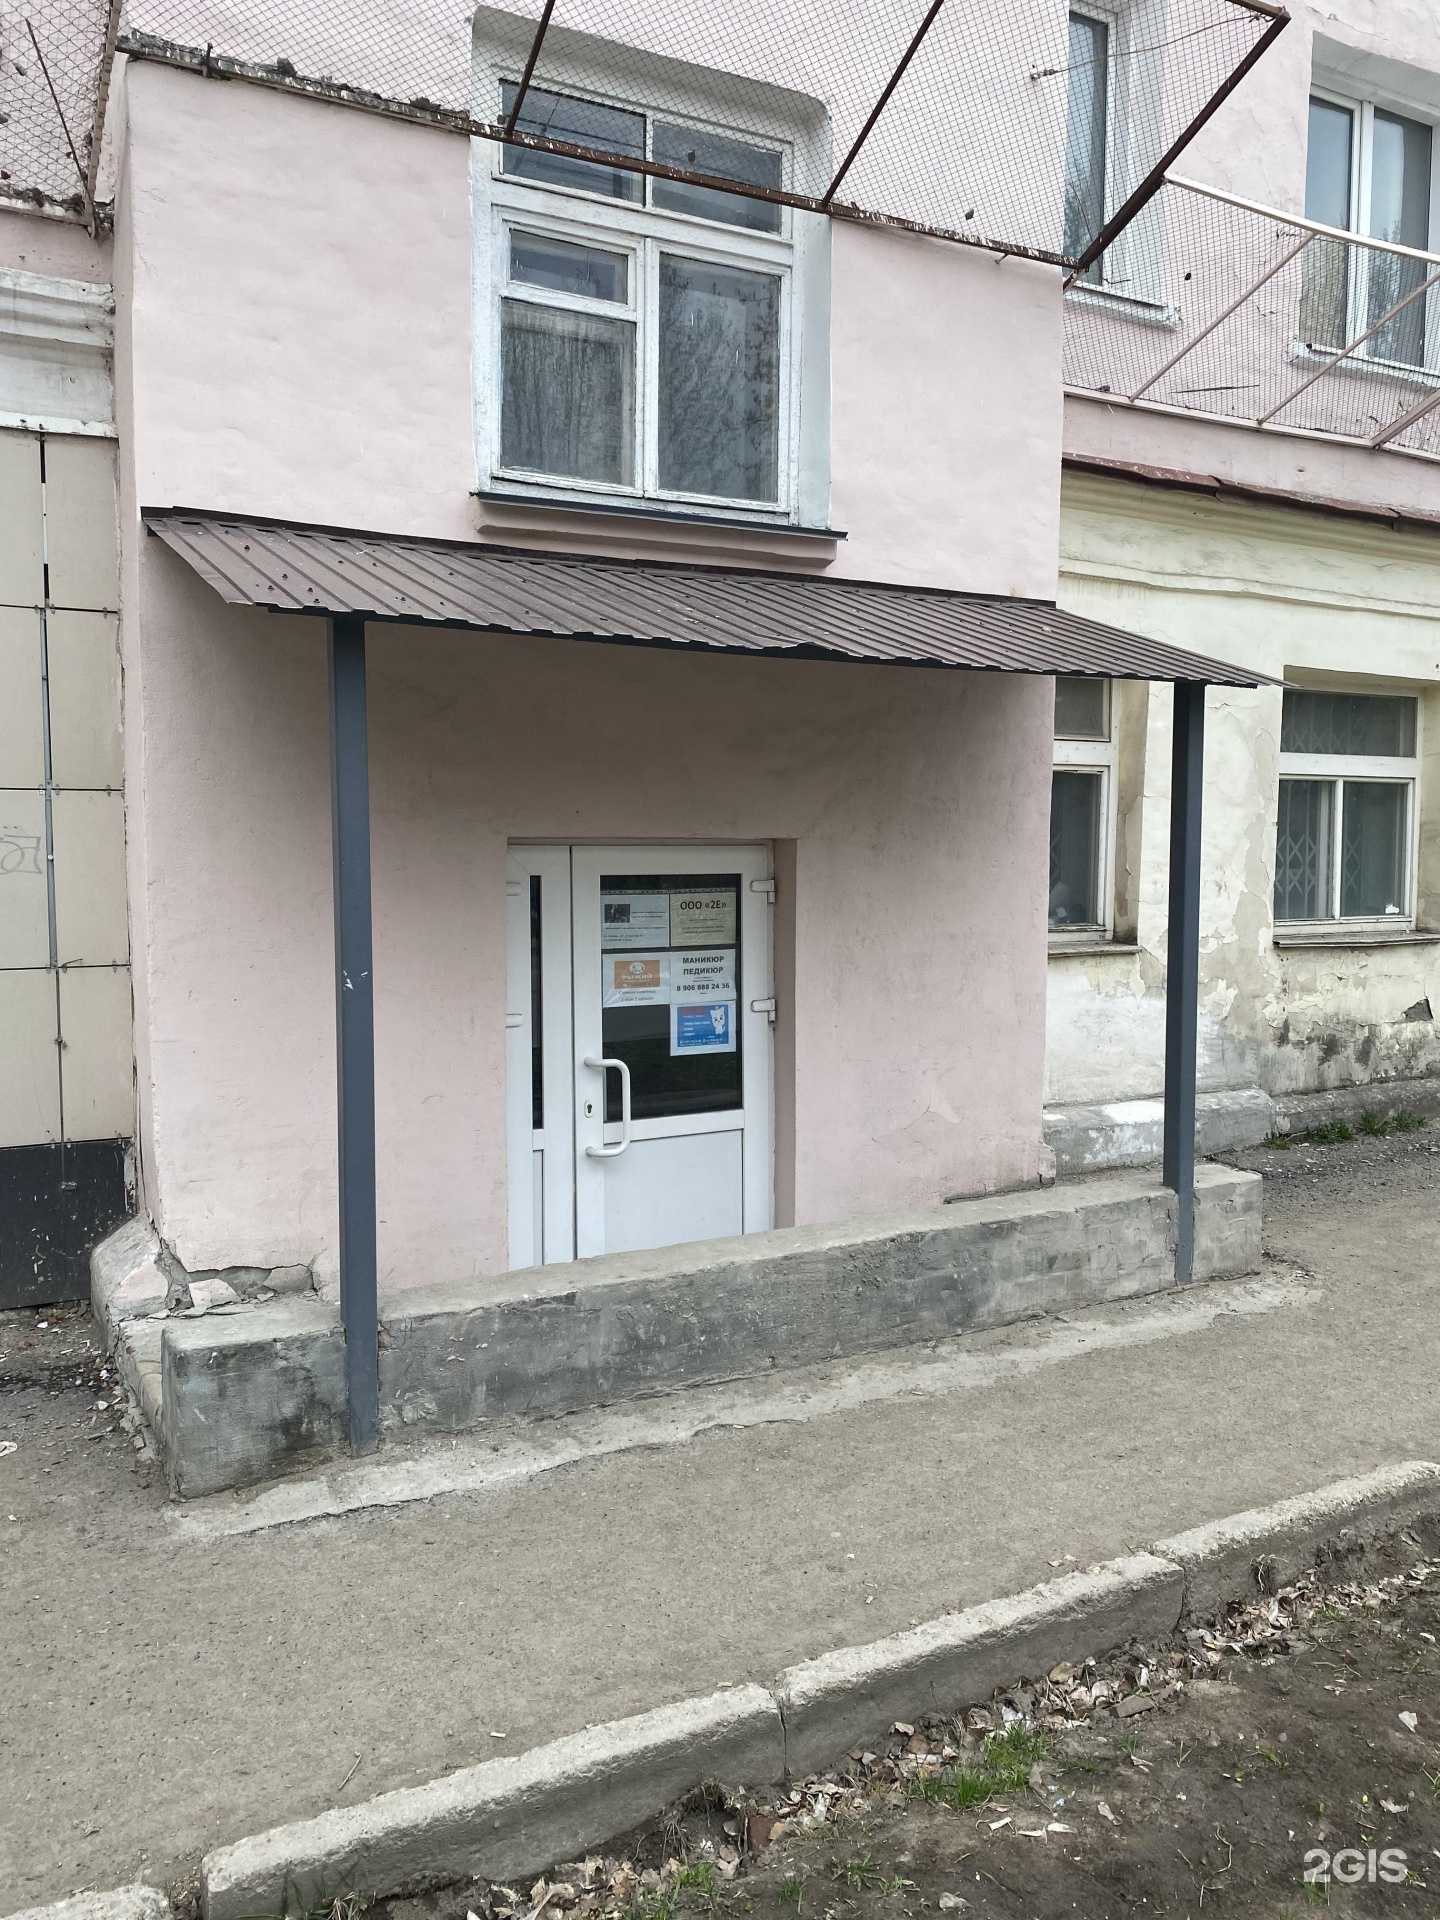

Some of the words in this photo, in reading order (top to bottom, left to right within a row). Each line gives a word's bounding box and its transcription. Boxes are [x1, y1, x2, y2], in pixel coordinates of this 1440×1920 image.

[680, 900, 702, 910] ООО
[682, 955, 725, 964] МАНИКЮР
[683, 966, 724, 976] ПЕДИКЮР
